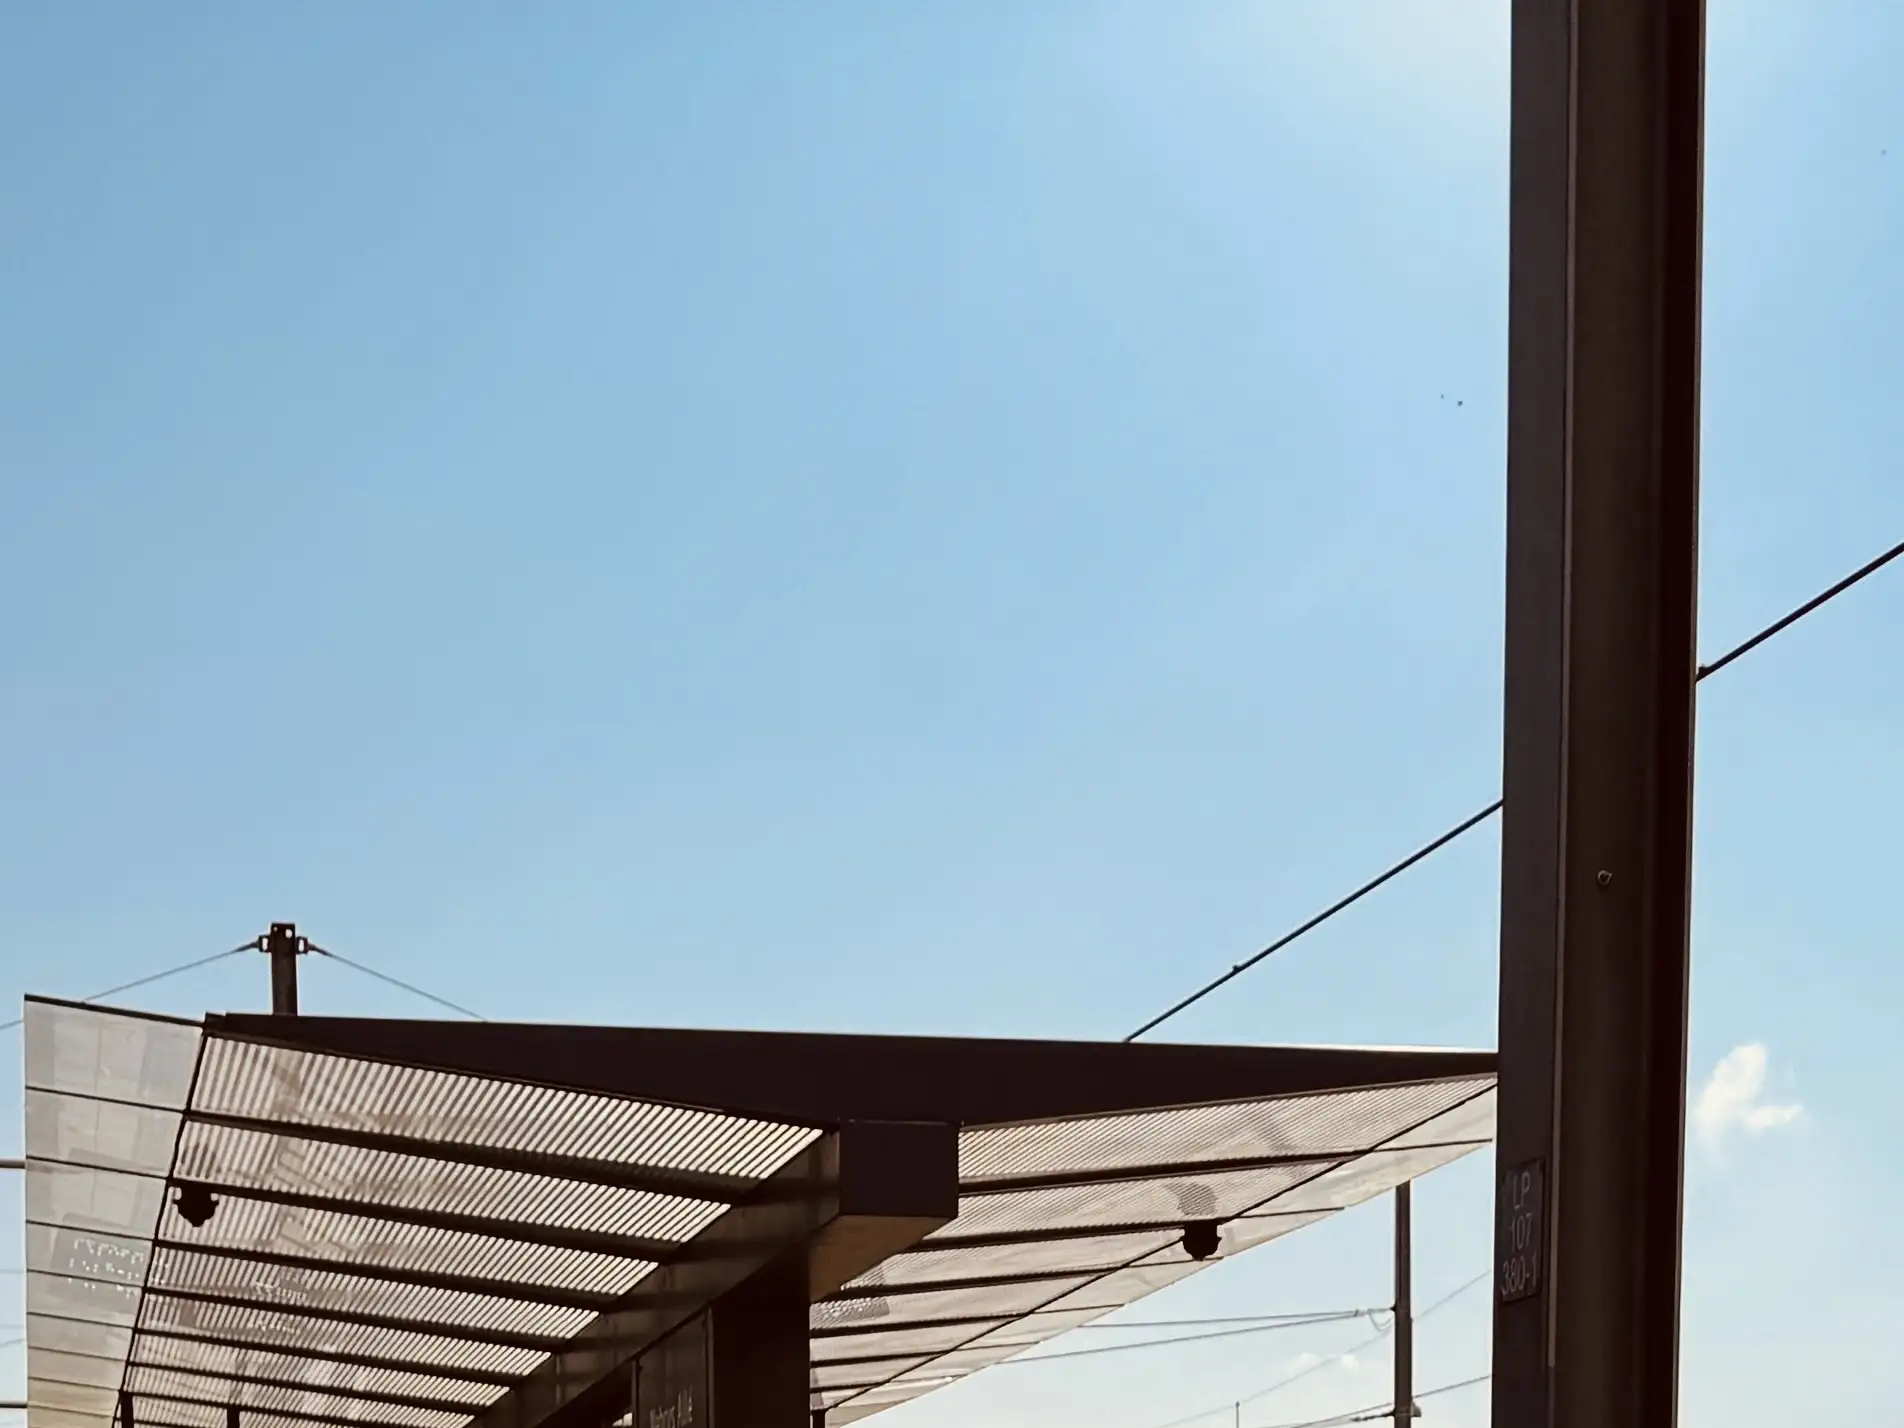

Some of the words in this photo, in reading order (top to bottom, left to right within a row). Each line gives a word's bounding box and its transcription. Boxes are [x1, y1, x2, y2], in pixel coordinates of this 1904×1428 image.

[1513, 1171, 1531, 1210] LP
[1511, 1213, 1533, 1251] 107
[1501, 1250, 1537, 1296] 380-1
